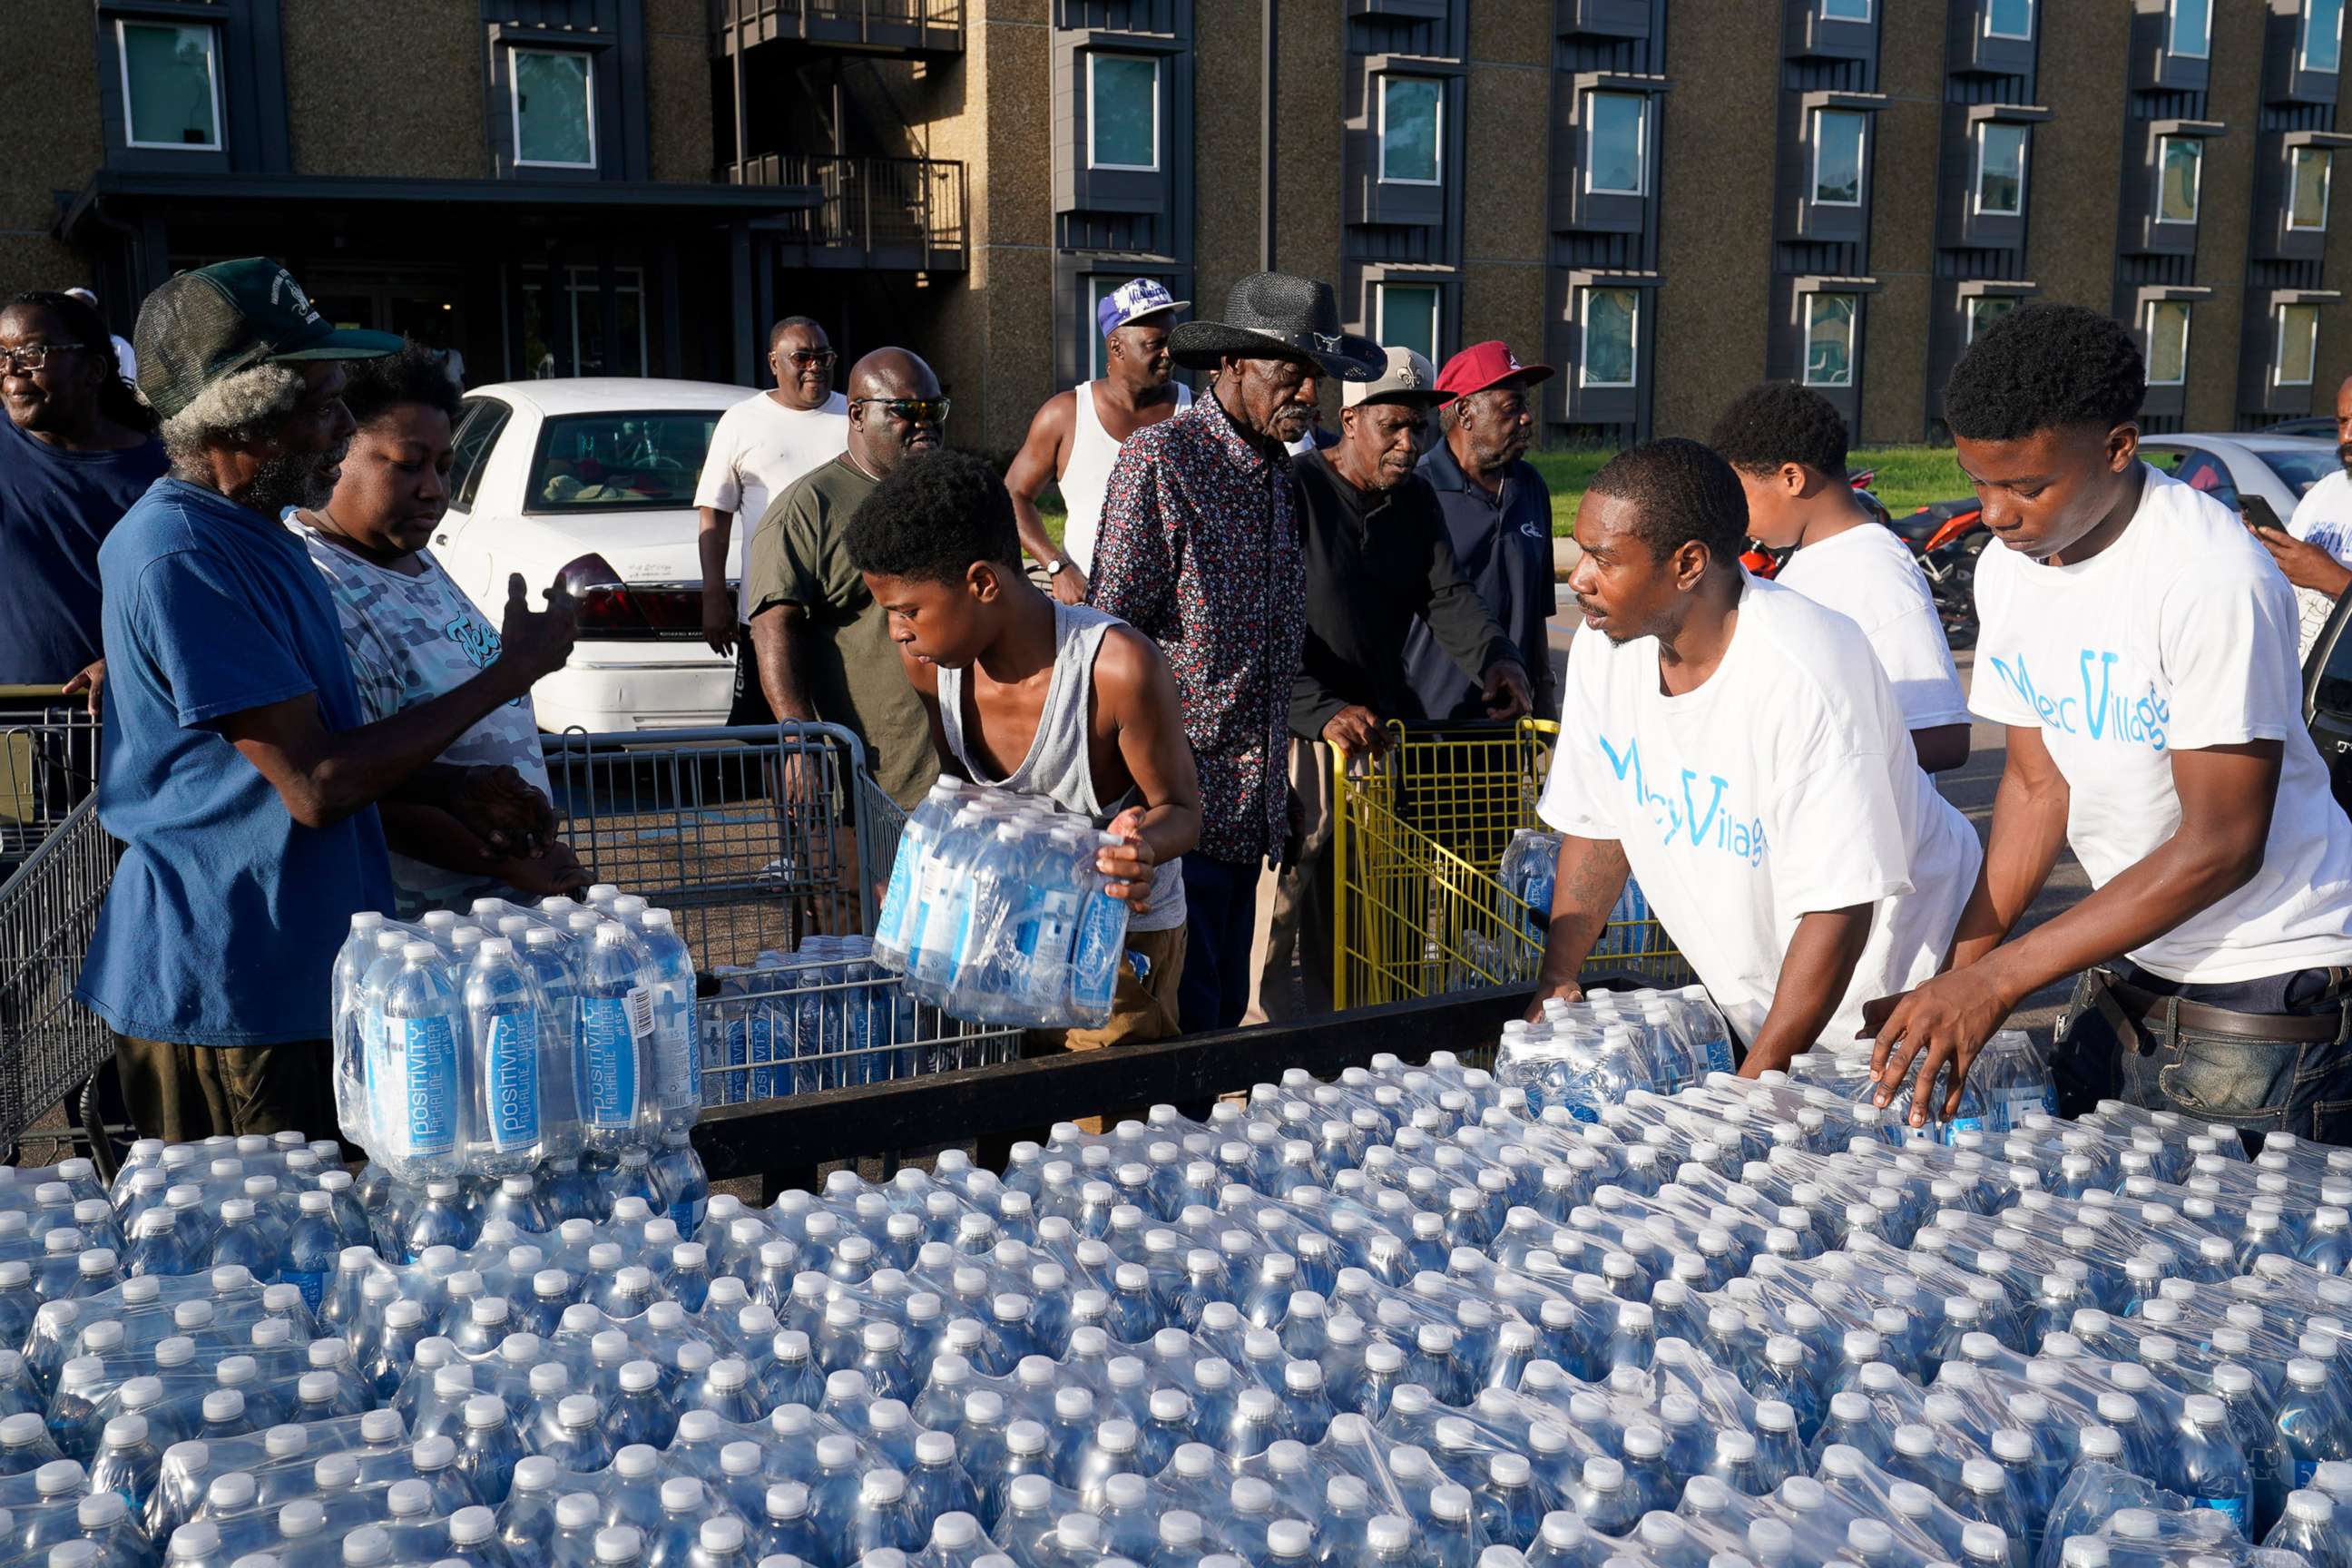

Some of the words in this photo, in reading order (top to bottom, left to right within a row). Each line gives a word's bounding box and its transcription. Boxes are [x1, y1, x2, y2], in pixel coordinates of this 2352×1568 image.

[427, 1022, 442, 1064] WATER
[517, 1020, 529, 1061] WATER
[601, 1005, 615, 1046] WATER
